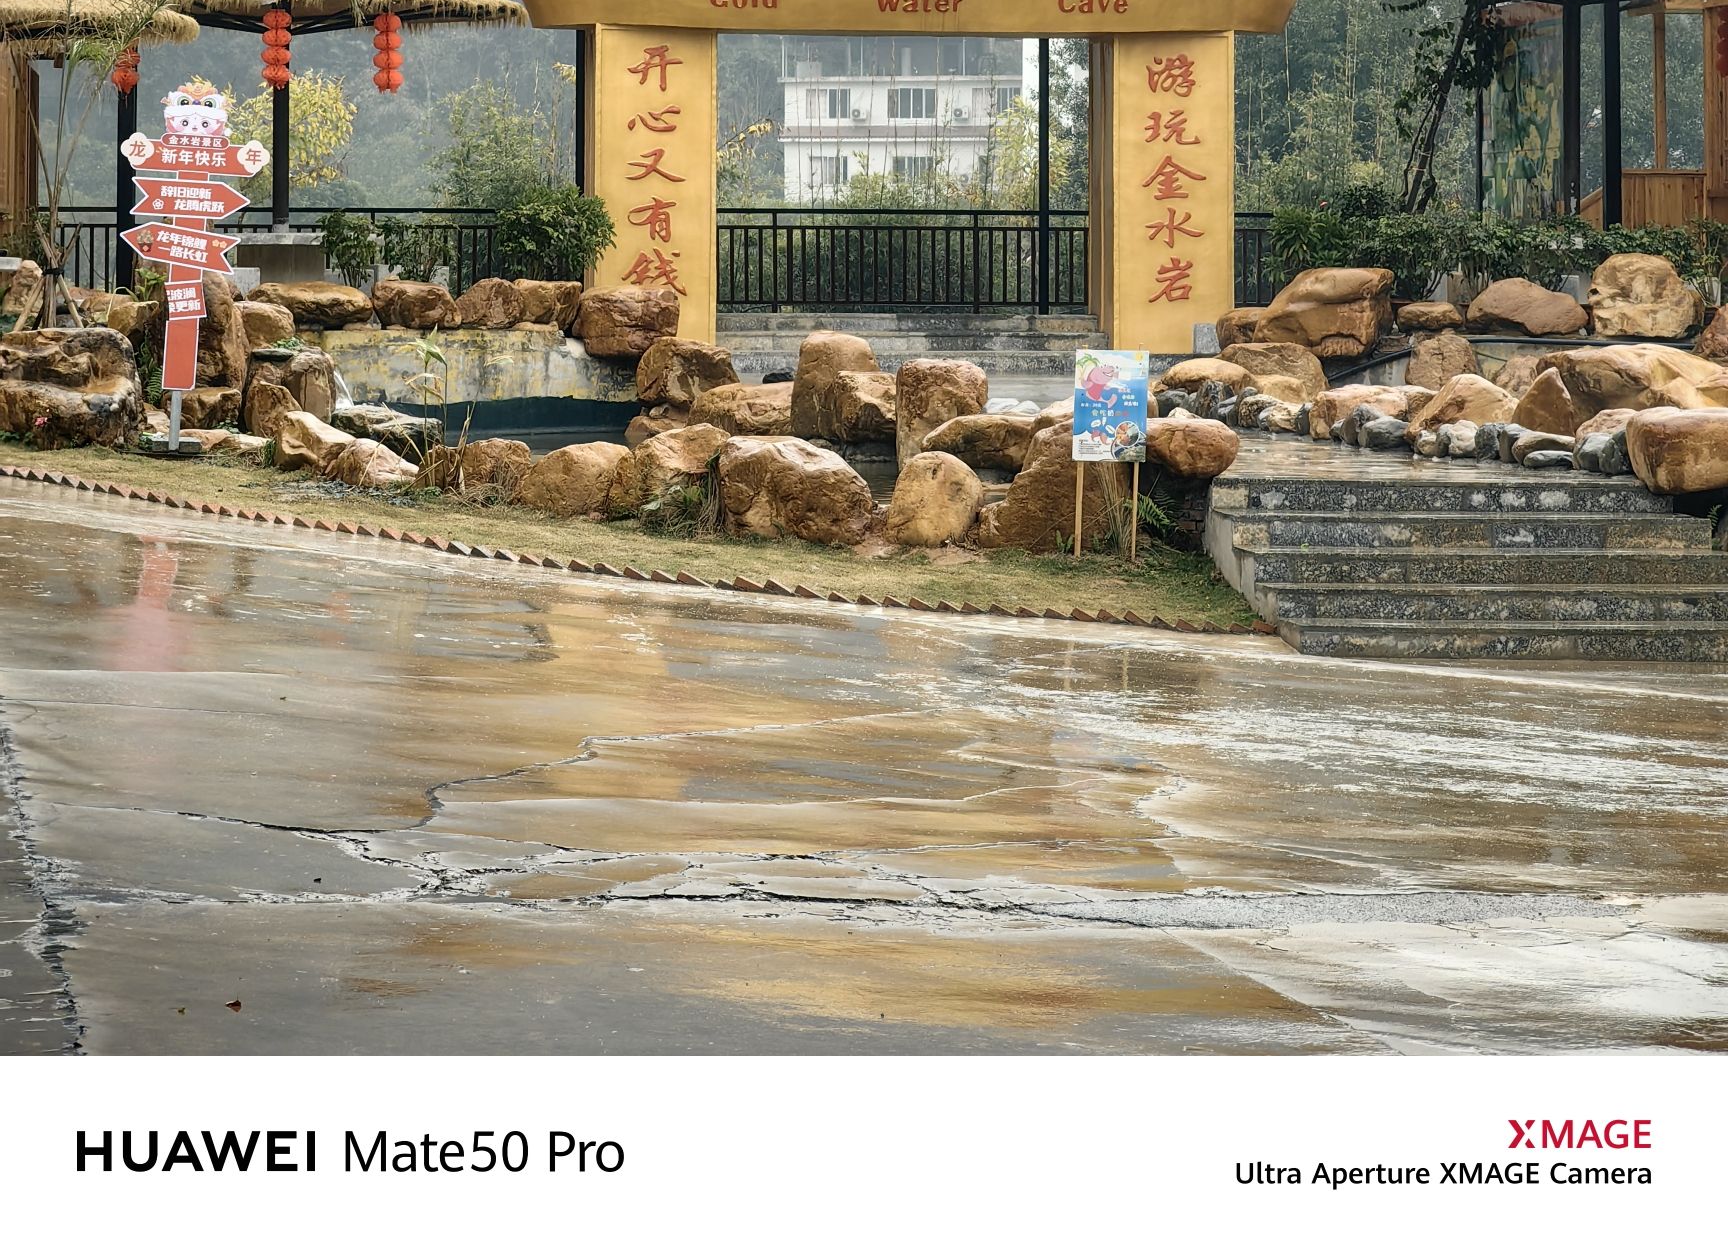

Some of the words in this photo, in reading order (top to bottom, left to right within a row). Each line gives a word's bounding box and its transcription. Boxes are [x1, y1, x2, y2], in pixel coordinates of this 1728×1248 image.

[129, 140, 146, 157] 龙
[167, 135, 224, 148] 金水岩景区
[160, 148, 227, 167] 新年快乐
[244, 149, 262, 165] 年
[621, 44, 687, 297] 开心又有钱
[1142, 53, 1207, 303] 游玩金水岩
[160, 185, 212, 200] 辞旧迎新
[174, 199, 225, 214] 龙腾虎跃
[157, 245, 209, 264] 一路长虹
